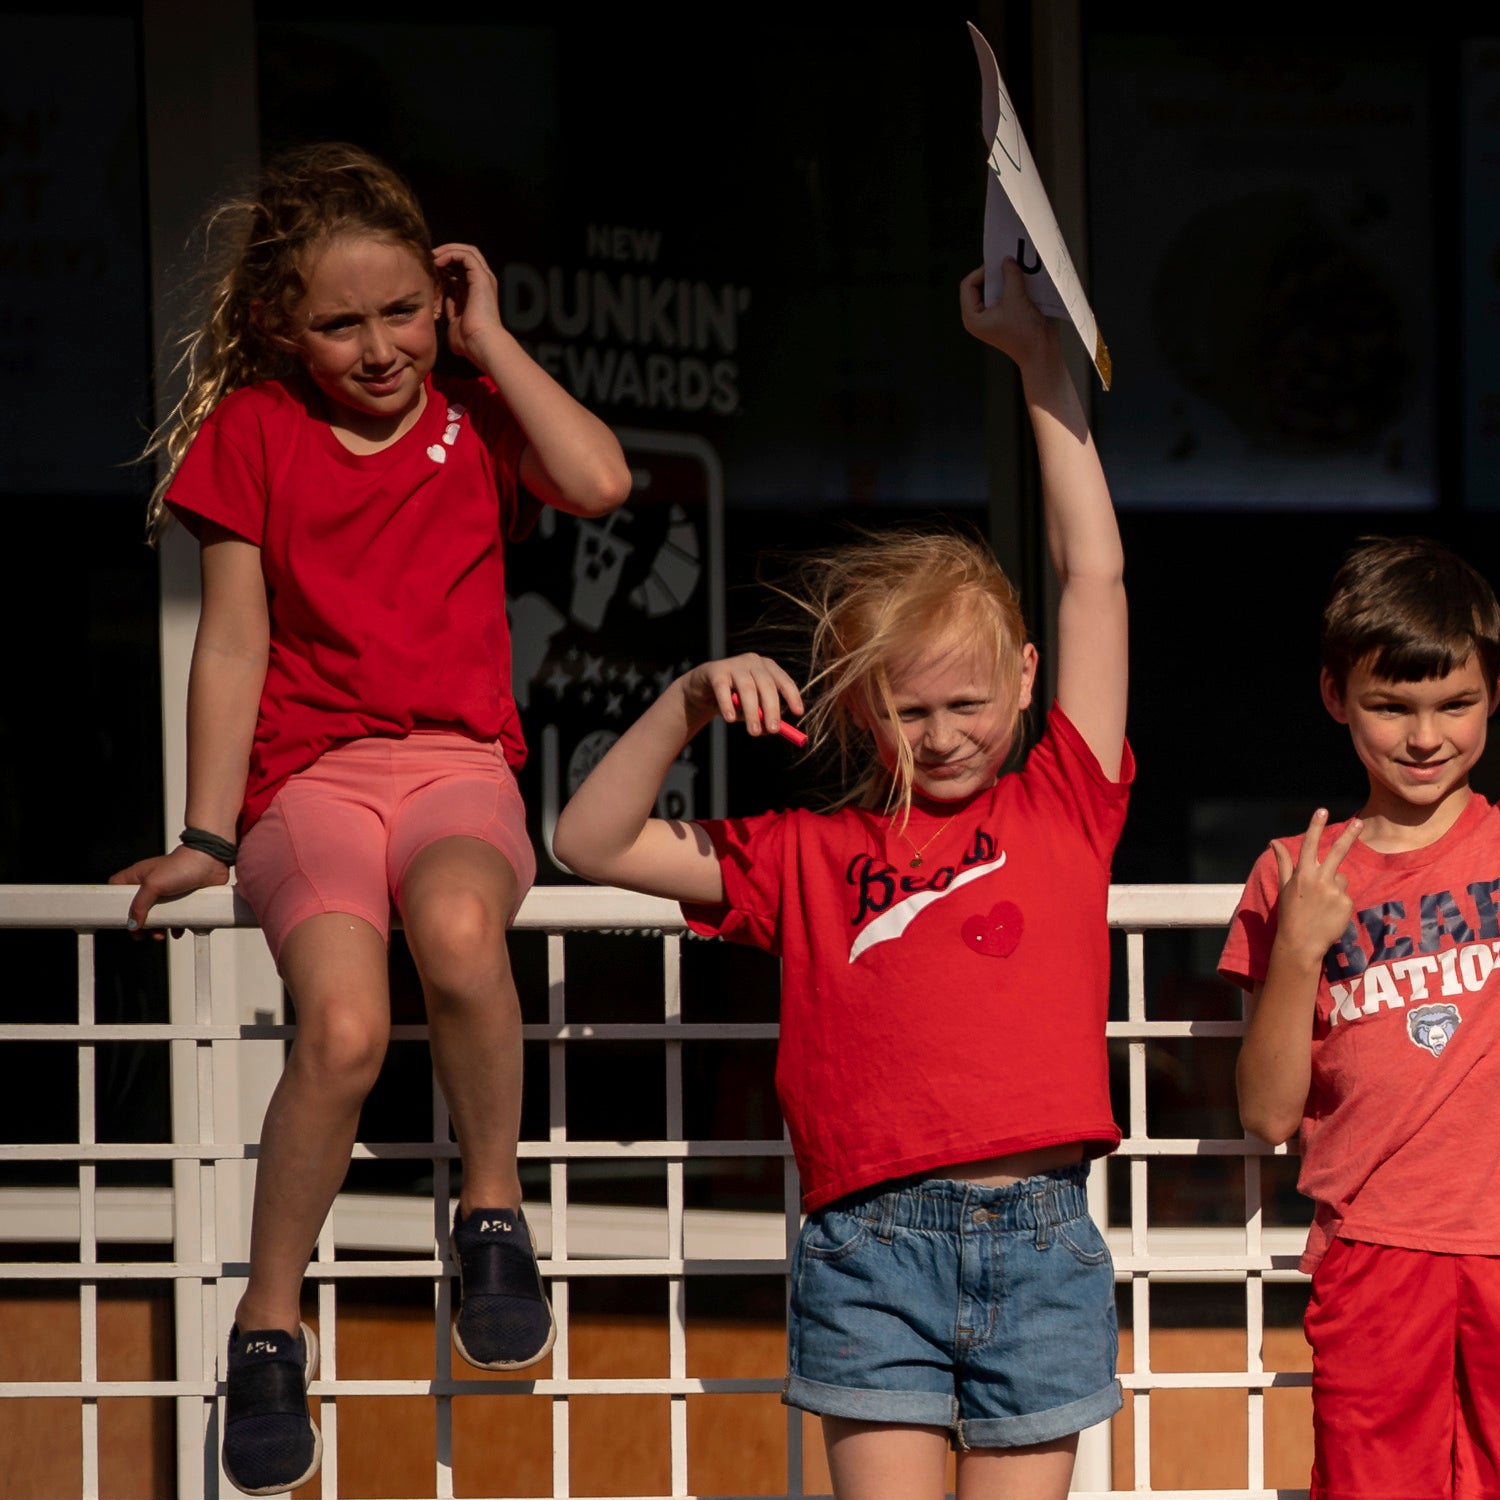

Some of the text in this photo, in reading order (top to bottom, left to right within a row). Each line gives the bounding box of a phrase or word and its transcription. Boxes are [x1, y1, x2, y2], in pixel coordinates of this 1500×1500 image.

[585, 220, 663, 265] NEW
[501, 261, 752, 355] DUNKIN'
[519, 340, 740, 417] EWARDS
